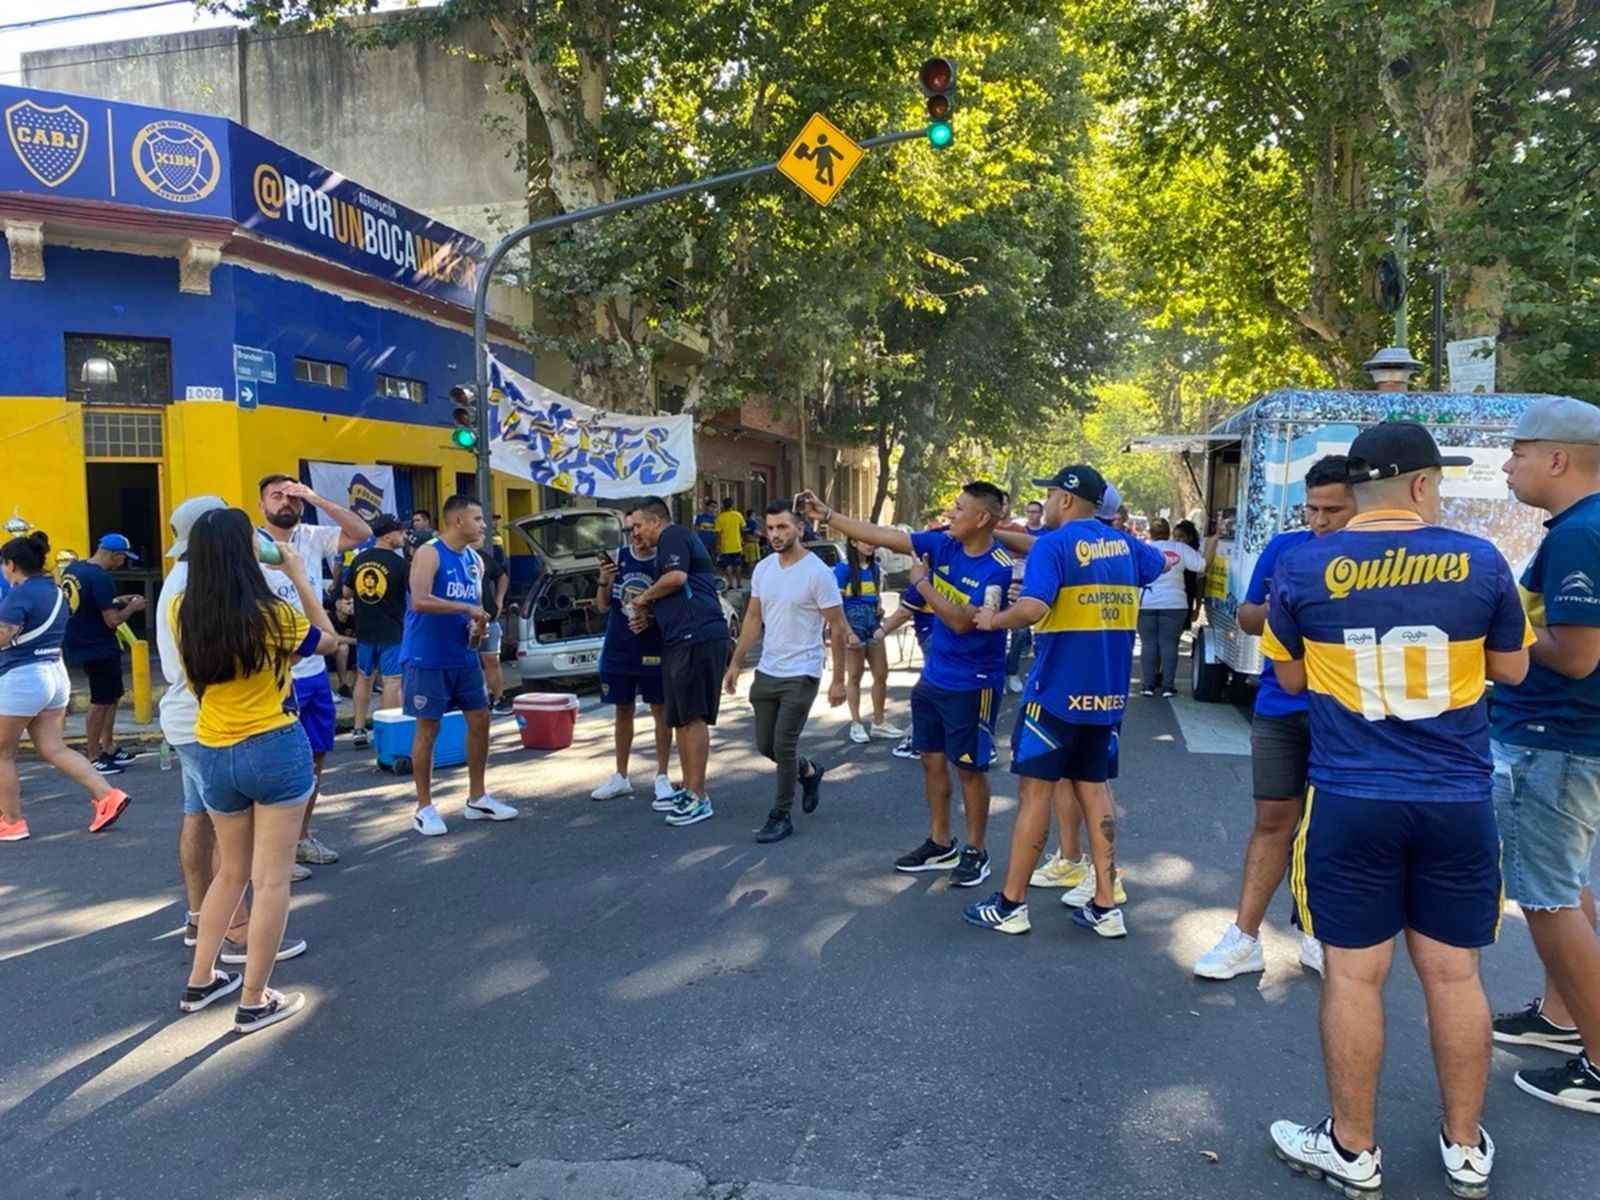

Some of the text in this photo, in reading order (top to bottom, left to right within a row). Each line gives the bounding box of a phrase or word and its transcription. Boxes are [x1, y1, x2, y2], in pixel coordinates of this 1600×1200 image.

[16, 126, 79, 149] CABJ
[187, 387, 221, 399] 1002
[1075, 537, 1131, 568] Quilmes
[1325, 547, 1470, 600] Quilmes
[446, 581, 477, 600] BBVA
[1343, 624, 1452, 722] 10
